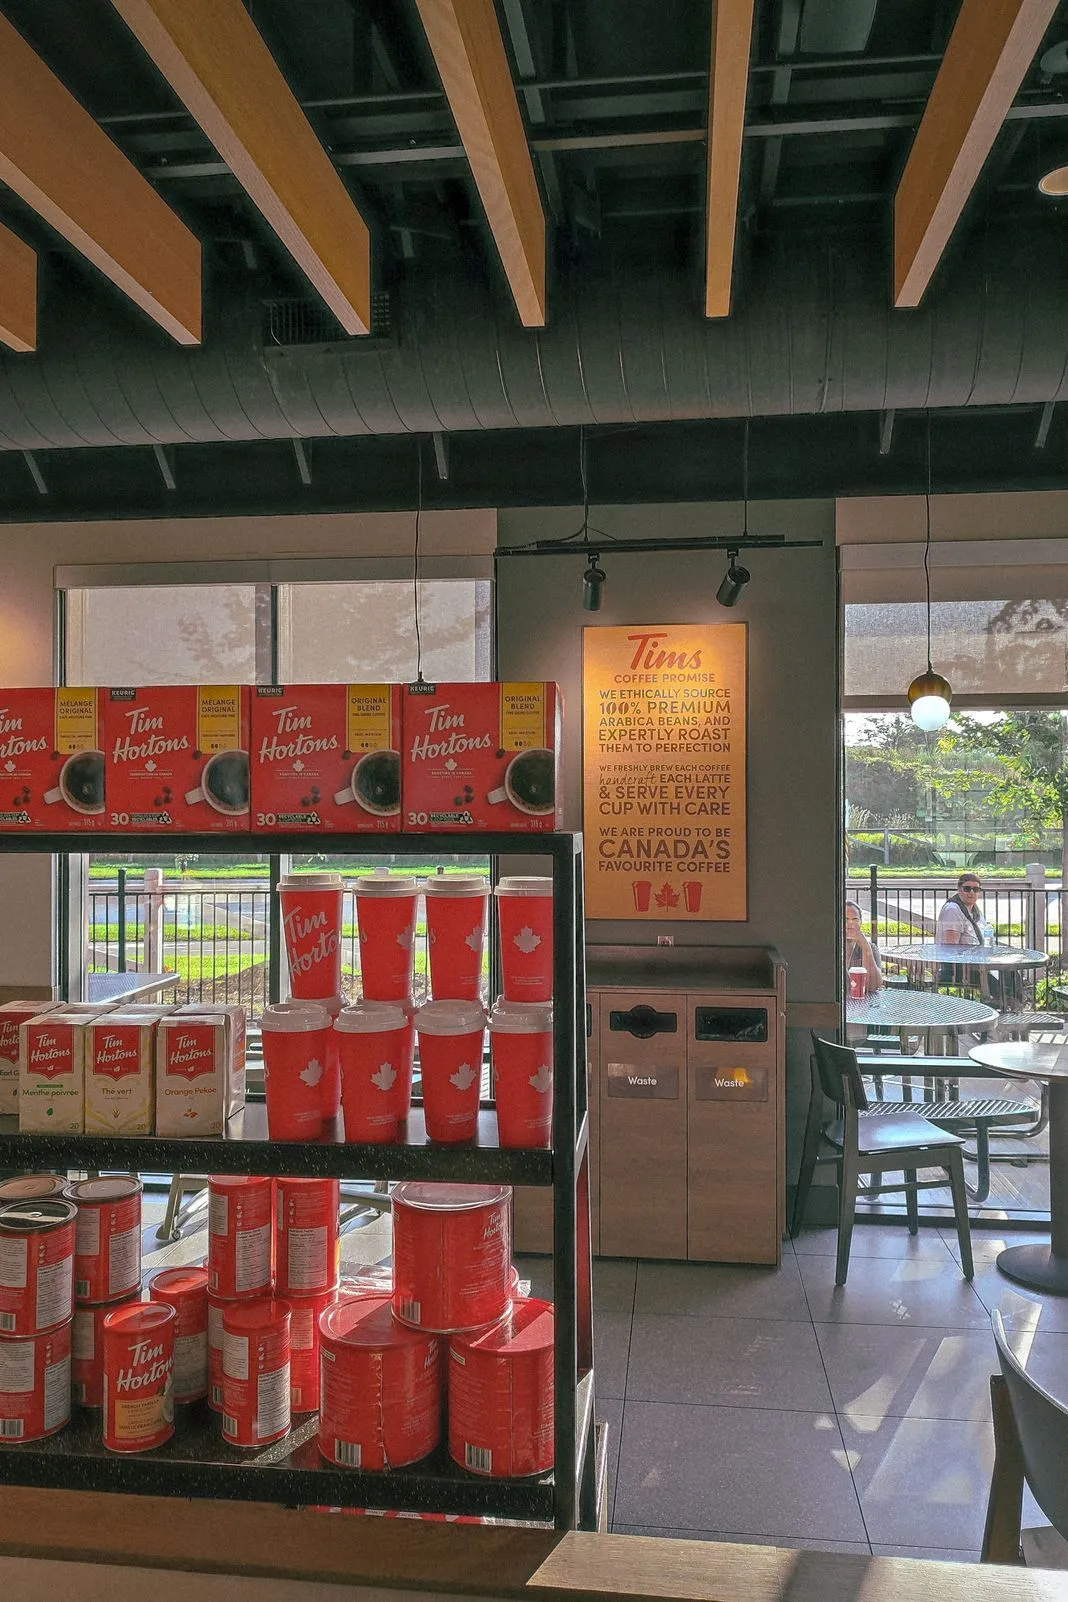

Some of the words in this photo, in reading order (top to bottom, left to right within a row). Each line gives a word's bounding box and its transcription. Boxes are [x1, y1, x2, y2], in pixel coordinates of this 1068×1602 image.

[627, 633, 703, 670] Tims
[614, 674, 658, 683] COFFEE
[662, 673, 715, 683] PROMISE
[599, 690, 617, 699] WE
[620, 689, 680, 699] ETHICALLY
[683, 688, 731, 698] SOURCE
[599, 701, 642, 715] 100%
[647, 700, 731, 714] PREMIUM
[125, 707, 164, 735] Tim
[272, 706, 312, 734] Tim
[424, 704, 465, 733] Tim
[599, 717, 654, 726] ARABICA
[658, 716, 701, 728] BEANS,
[704, 716, 731, 726] AND
[598, 728, 674, 741] EXPERTLY
[678, 728, 731, 740] ROAST
[112, 735, 190, 764] Hortons
[259, 734, 339, 763] Hortons
[411, 733, 492, 762] Hortons
[599, 743, 633, 752] THEM
[636, 743, 652, 752] TO
[655, 743, 731, 752] PERFECTION
[599, 764, 612, 772] WE
[613, 764, 648, 772] FRESHLY
[650, 764, 673, 772] BREW
[599, 770, 657, 787] handcraft
[660, 773, 692, 783] EACH
[695, 773, 731, 783] LATTE
[599, 786, 611, 799] &
[615, 786, 669, 799] SERVE
[674, 785, 730, 799] EVERY
[599, 801, 633, 815] CUP
[637, 801, 681, 815] WITH
[684, 801, 731, 815] CARE
[110, 812, 130, 826] 30
[256, 813, 276, 826] 30
[407, 812, 428, 825] 30
[599, 827, 617, 837] WE
[620, 828, 644, 837] ARE
[648, 828, 692, 837] PROUD
[695, 828, 711, 837] TO
[715, 828, 731, 837] BE
[598, 839, 731, 859] CANADA'S
[598, 860, 673, 872] FAVOURITE
[676, 862, 731, 872] COFFEE
[284, 906, 328, 944] Tim
[288, 929, 337, 983] Horto
[36, 1033, 57, 1048] Tim
[102, 1034, 123, 1048] Tim
[175, 1034, 198, 1048] Tim
[31, 1048, 71, 1063] Hortons
[96, 1048, 137, 1064] Hortons
[170, 1048, 212, 1065] Hortons
[628, 1075, 657, 1086] Waste
[714, 1077, 745, 1088] Waste
[22, 1088, 51, 1096] Menthe
[117, 1087, 133, 1095] vert
[164, 1088, 194, 1097] Orange
[194, 1086, 217, 1095] Pekoe
[69, 1122, 80, 1130] 20
[136, 1123, 147, 1131] 20
[210, 1122, 221, 1130] 20
[126, 1339, 163, 1368] Tim
[116, 1355, 174, 1393] Horton
